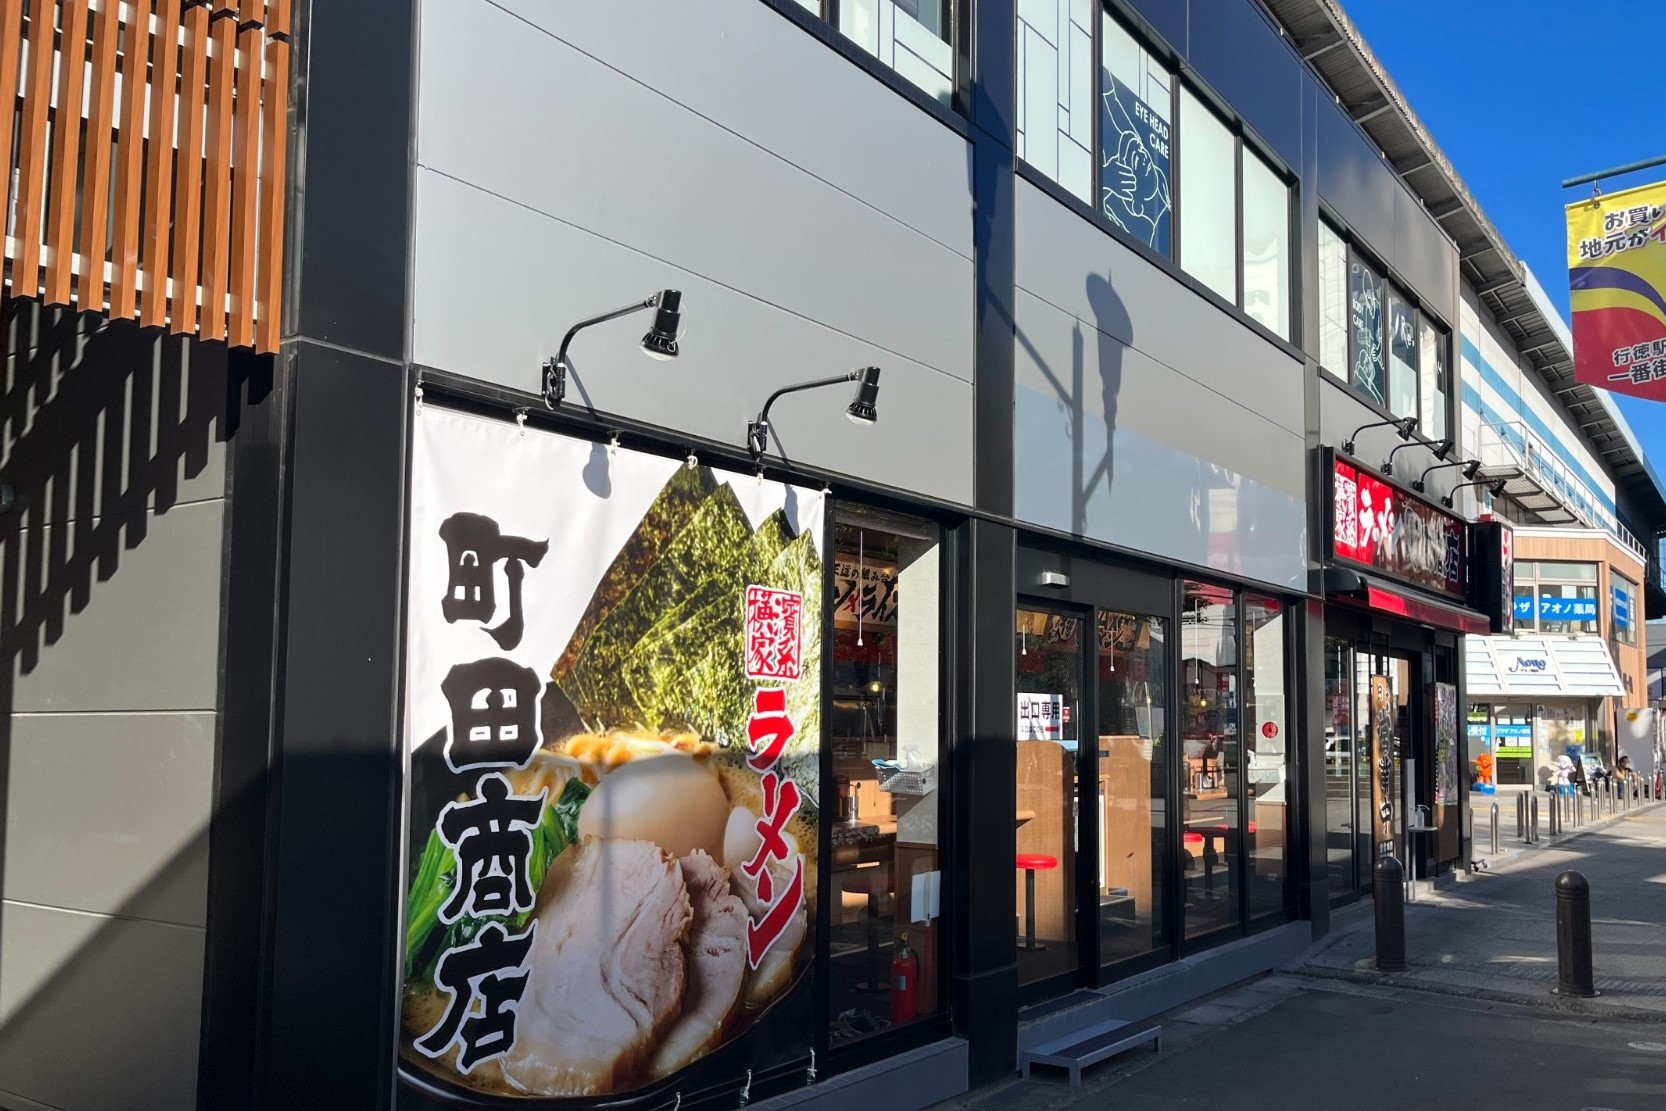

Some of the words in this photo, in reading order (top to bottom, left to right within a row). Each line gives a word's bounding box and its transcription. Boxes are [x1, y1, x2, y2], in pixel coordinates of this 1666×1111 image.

[1135, 101, 1148, 123] EYE
[1149, 113, 1169, 140] HEAD
[1149, 133, 1169, 159] CARE
[1541, 602, 1596, 615] アオノ薬局
[1020, 700, 1060, 720] 出口専用
[415, 511, 549, 1075] 町田商店
[743, 687, 802, 968] ラーメン
